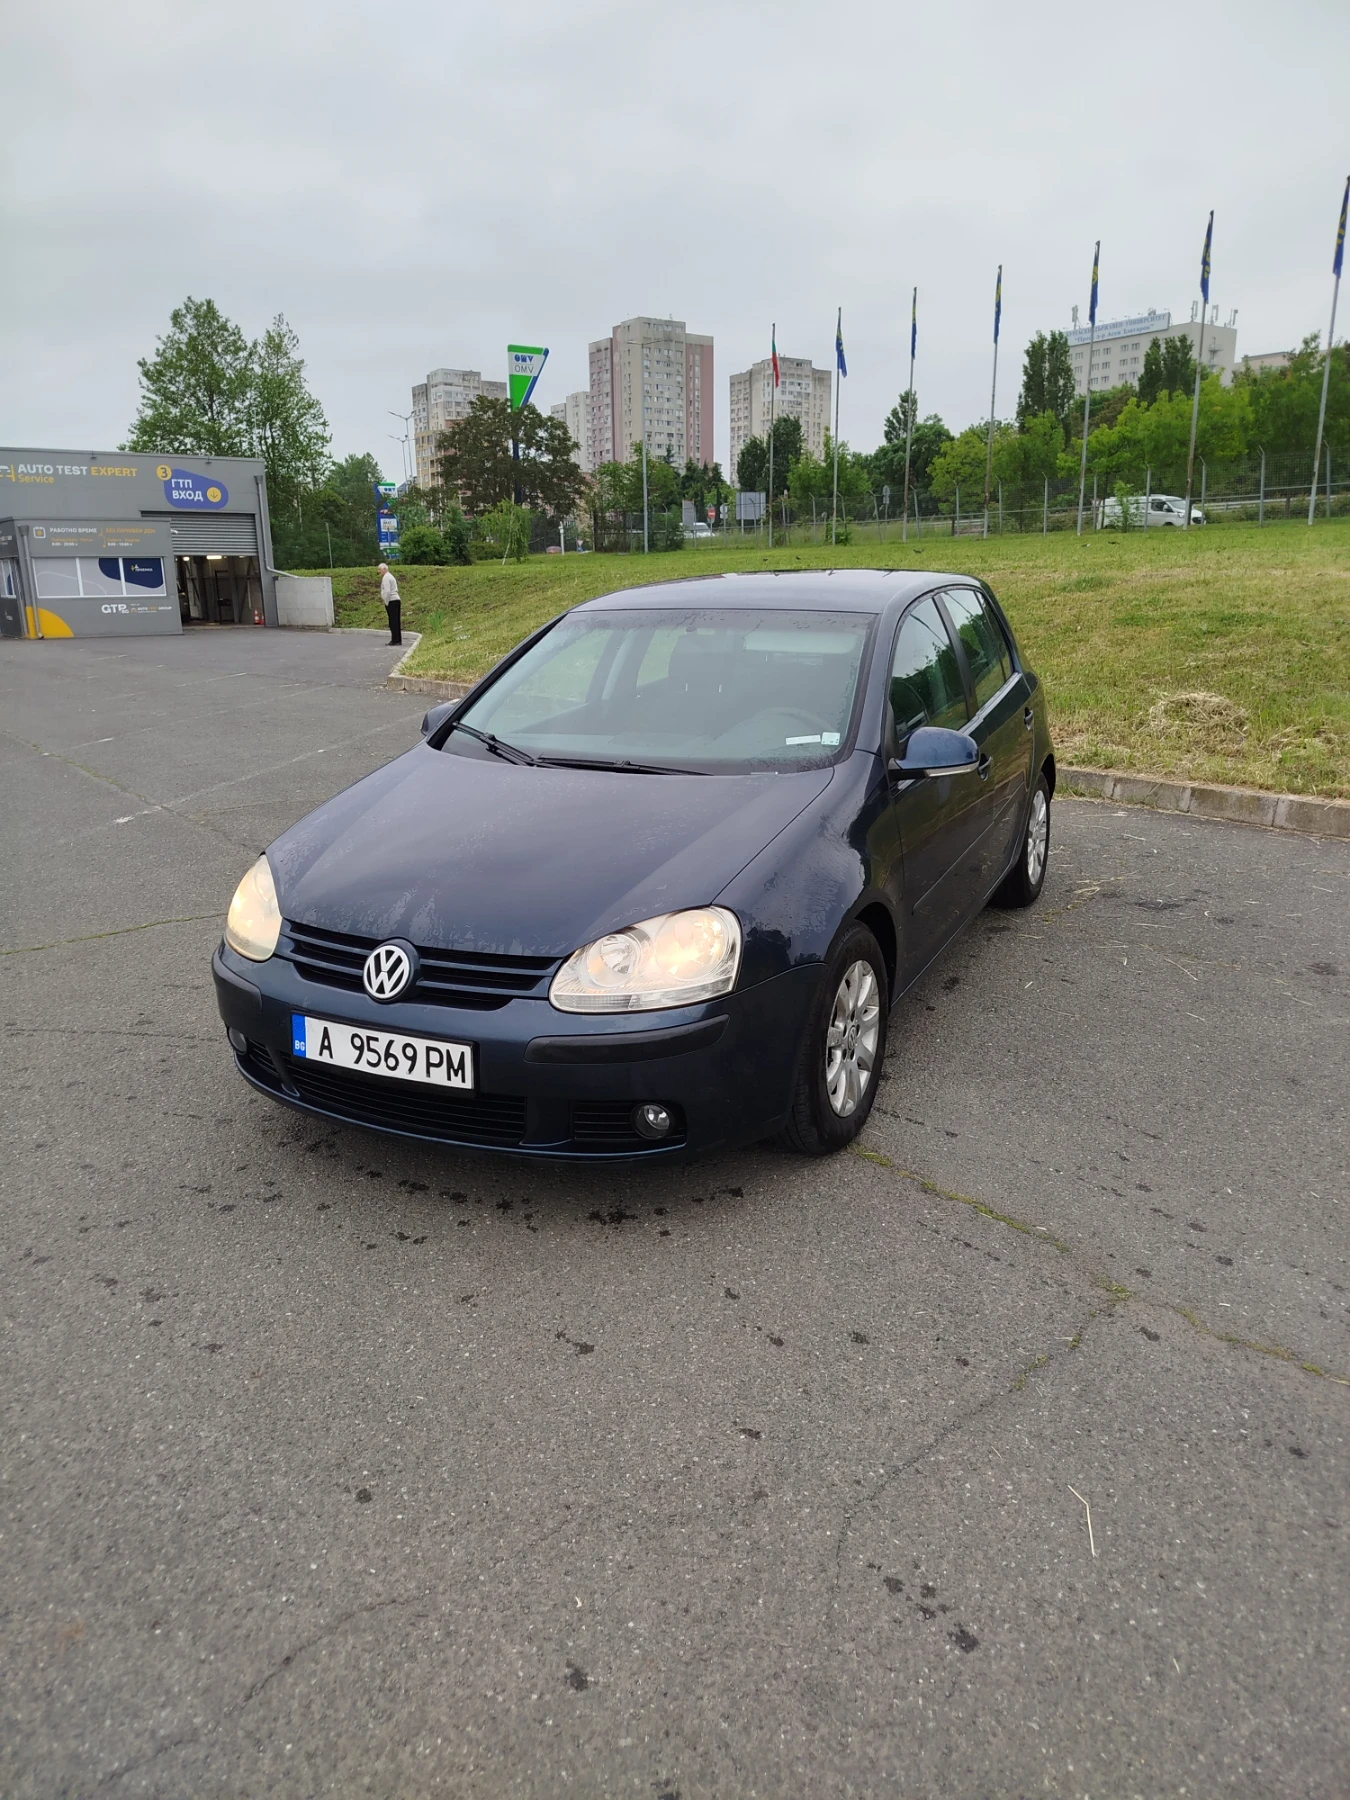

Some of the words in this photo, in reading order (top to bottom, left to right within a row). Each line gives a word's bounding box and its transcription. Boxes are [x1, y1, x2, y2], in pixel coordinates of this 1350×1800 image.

[514, 365, 534, 374] OMV
[18, 463, 54, 474] AUTO
[56, 465, 88, 475] TEST
[90, 466, 138, 477] EXPERT
[160, 467, 168, 478] 3
[18, 474, 55, 484] Service
[171, 478, 193, 489] ГТП
[172, 490, 204, 502] ВХОД
[101, 603, 127, 614] GTP
[294, 1040, 306, 1052] BG
[350, 1032, 418, 1075] 9569
